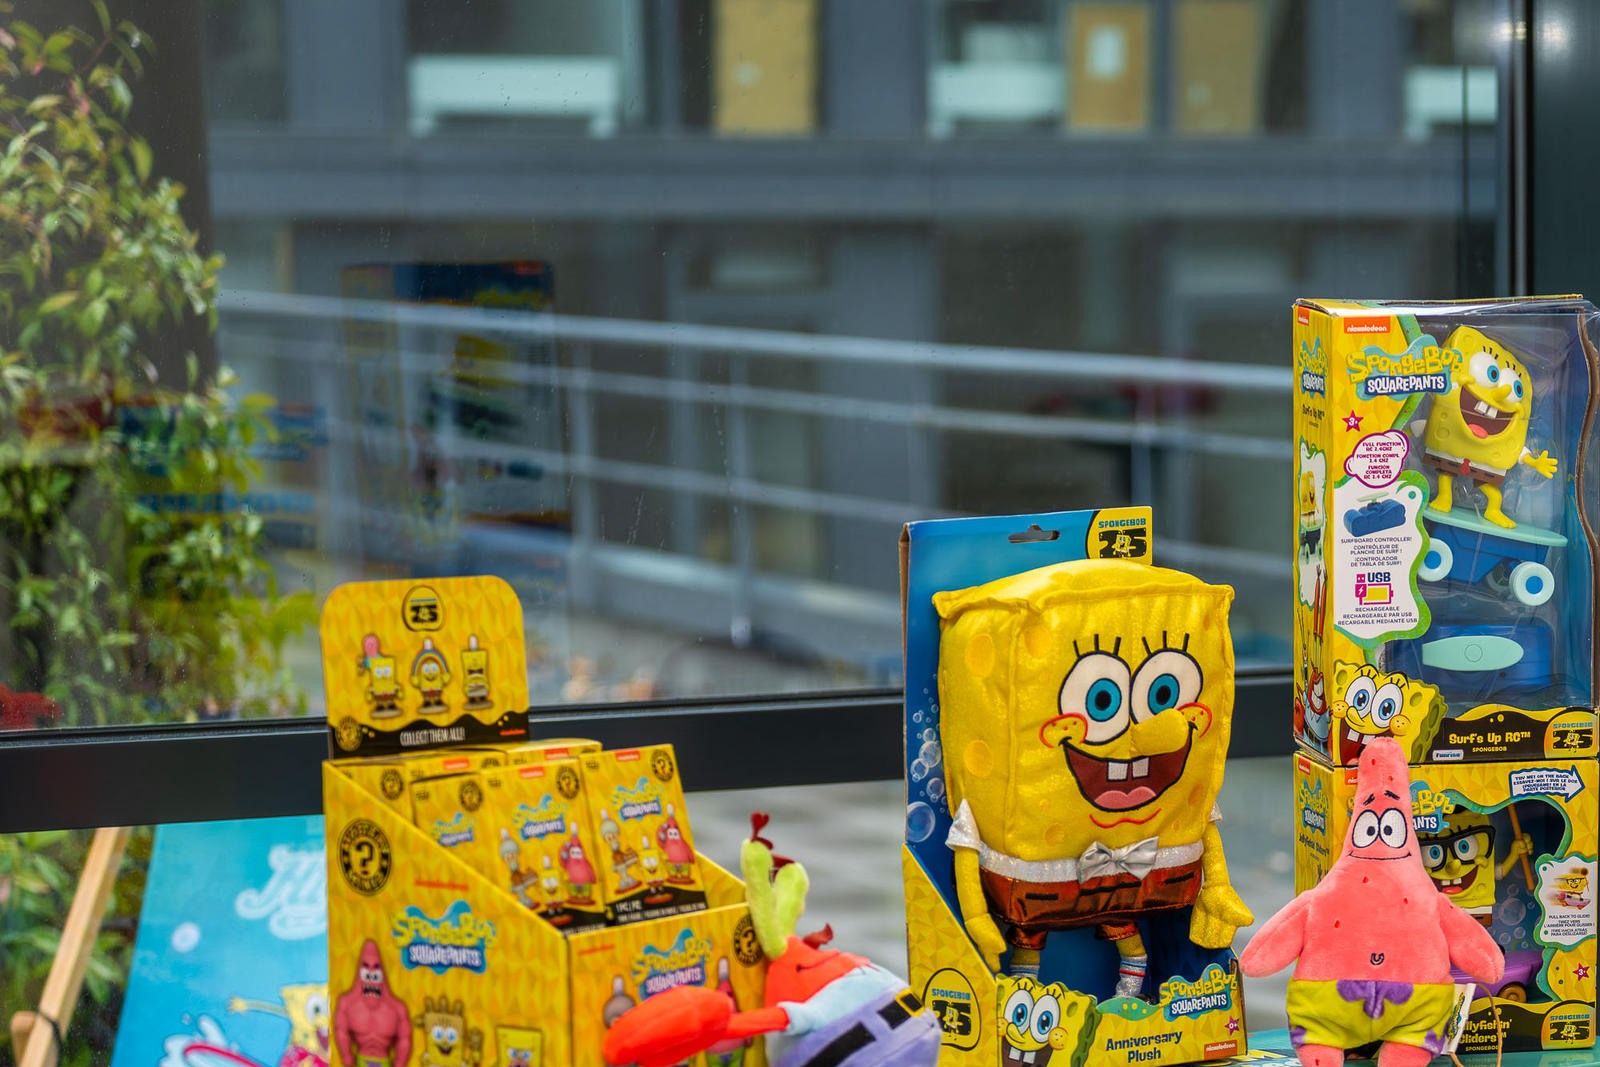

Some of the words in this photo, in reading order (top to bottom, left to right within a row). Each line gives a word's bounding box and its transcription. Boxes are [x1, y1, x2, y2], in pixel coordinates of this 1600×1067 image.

[1347, 345, 1463, 384] SpongeBob
[1367, 376, 1445, 394] SQUAREPANTS
[1098, 518, 1146, 528] SPONGEBOB
[1367, 572, 1391, 583] USB
[1449, 733, 1484, 745] Surf's
[1487, 733, 1502, 745] Up
[1159, 969, 1237, 1007] SpongeBob
[1171, 994, 1227, 1014] SQUAREPANTS
[1464, 1018, 1512, 1034] llyfishin'
[1106, 1031, 1182, 1051] Anniversary
[1127, 1047, 1161, 1063] Plush
